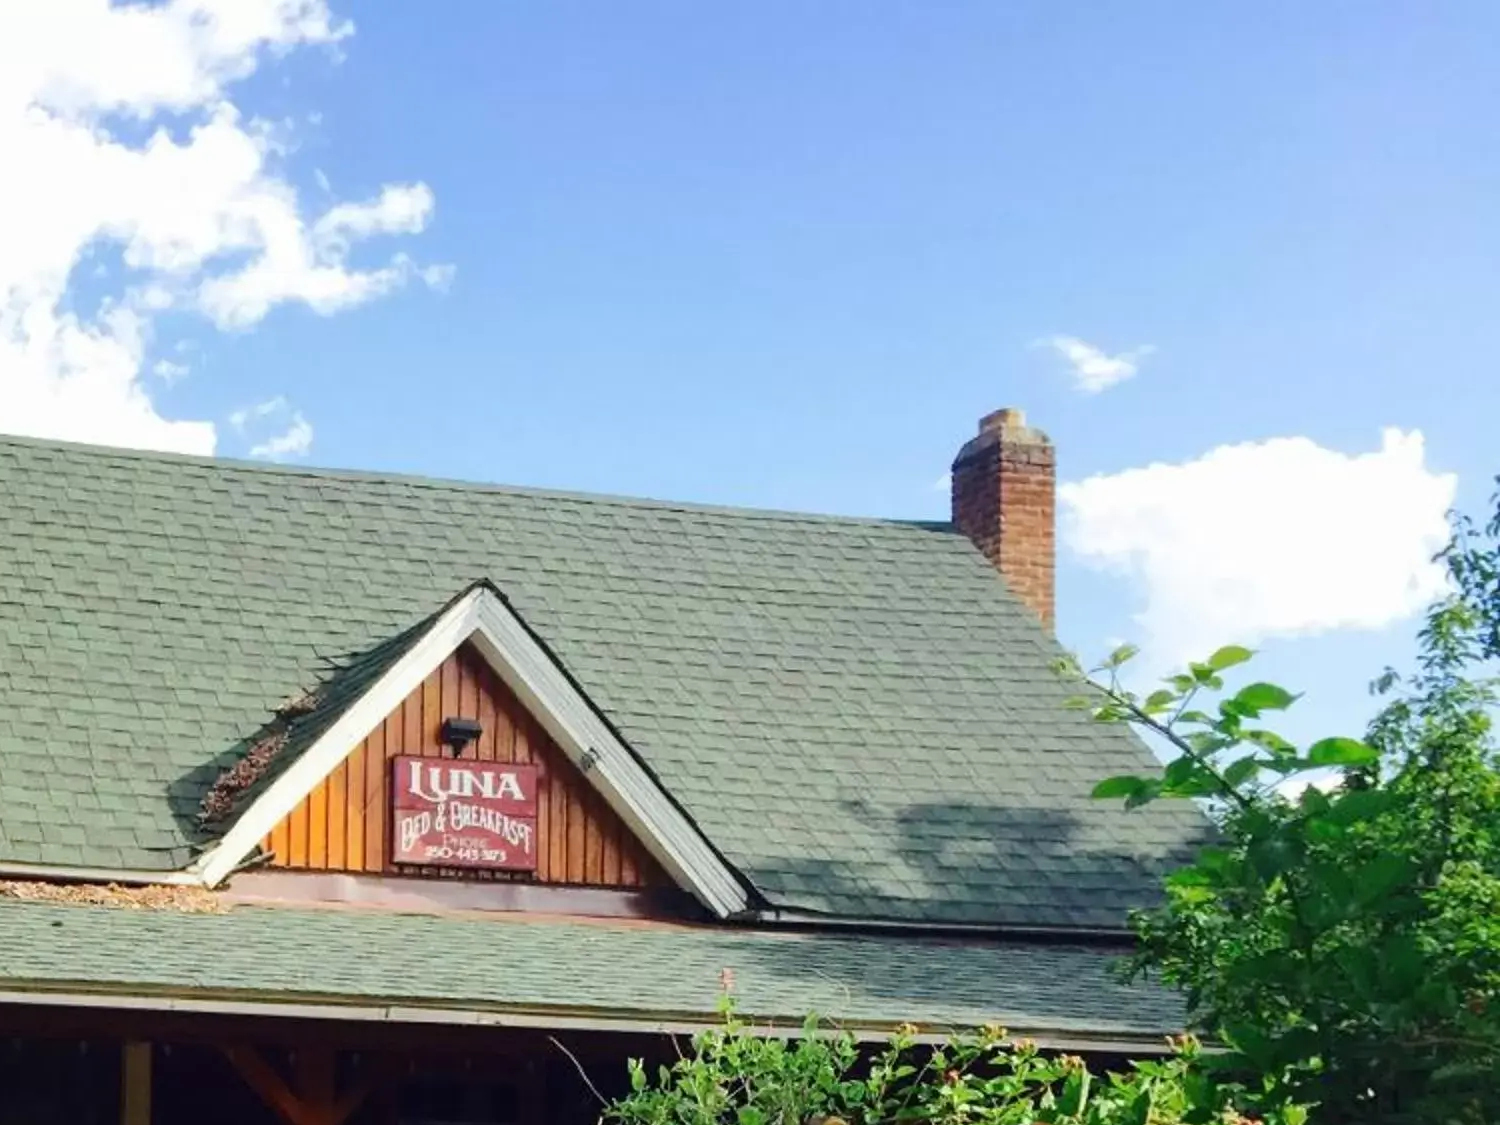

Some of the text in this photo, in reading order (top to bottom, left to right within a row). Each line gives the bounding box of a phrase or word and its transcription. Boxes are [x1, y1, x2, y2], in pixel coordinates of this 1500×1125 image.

[409, 761, 525, 802] LUNA
[401, 802, 532, 854] BED & BREAKFAST
